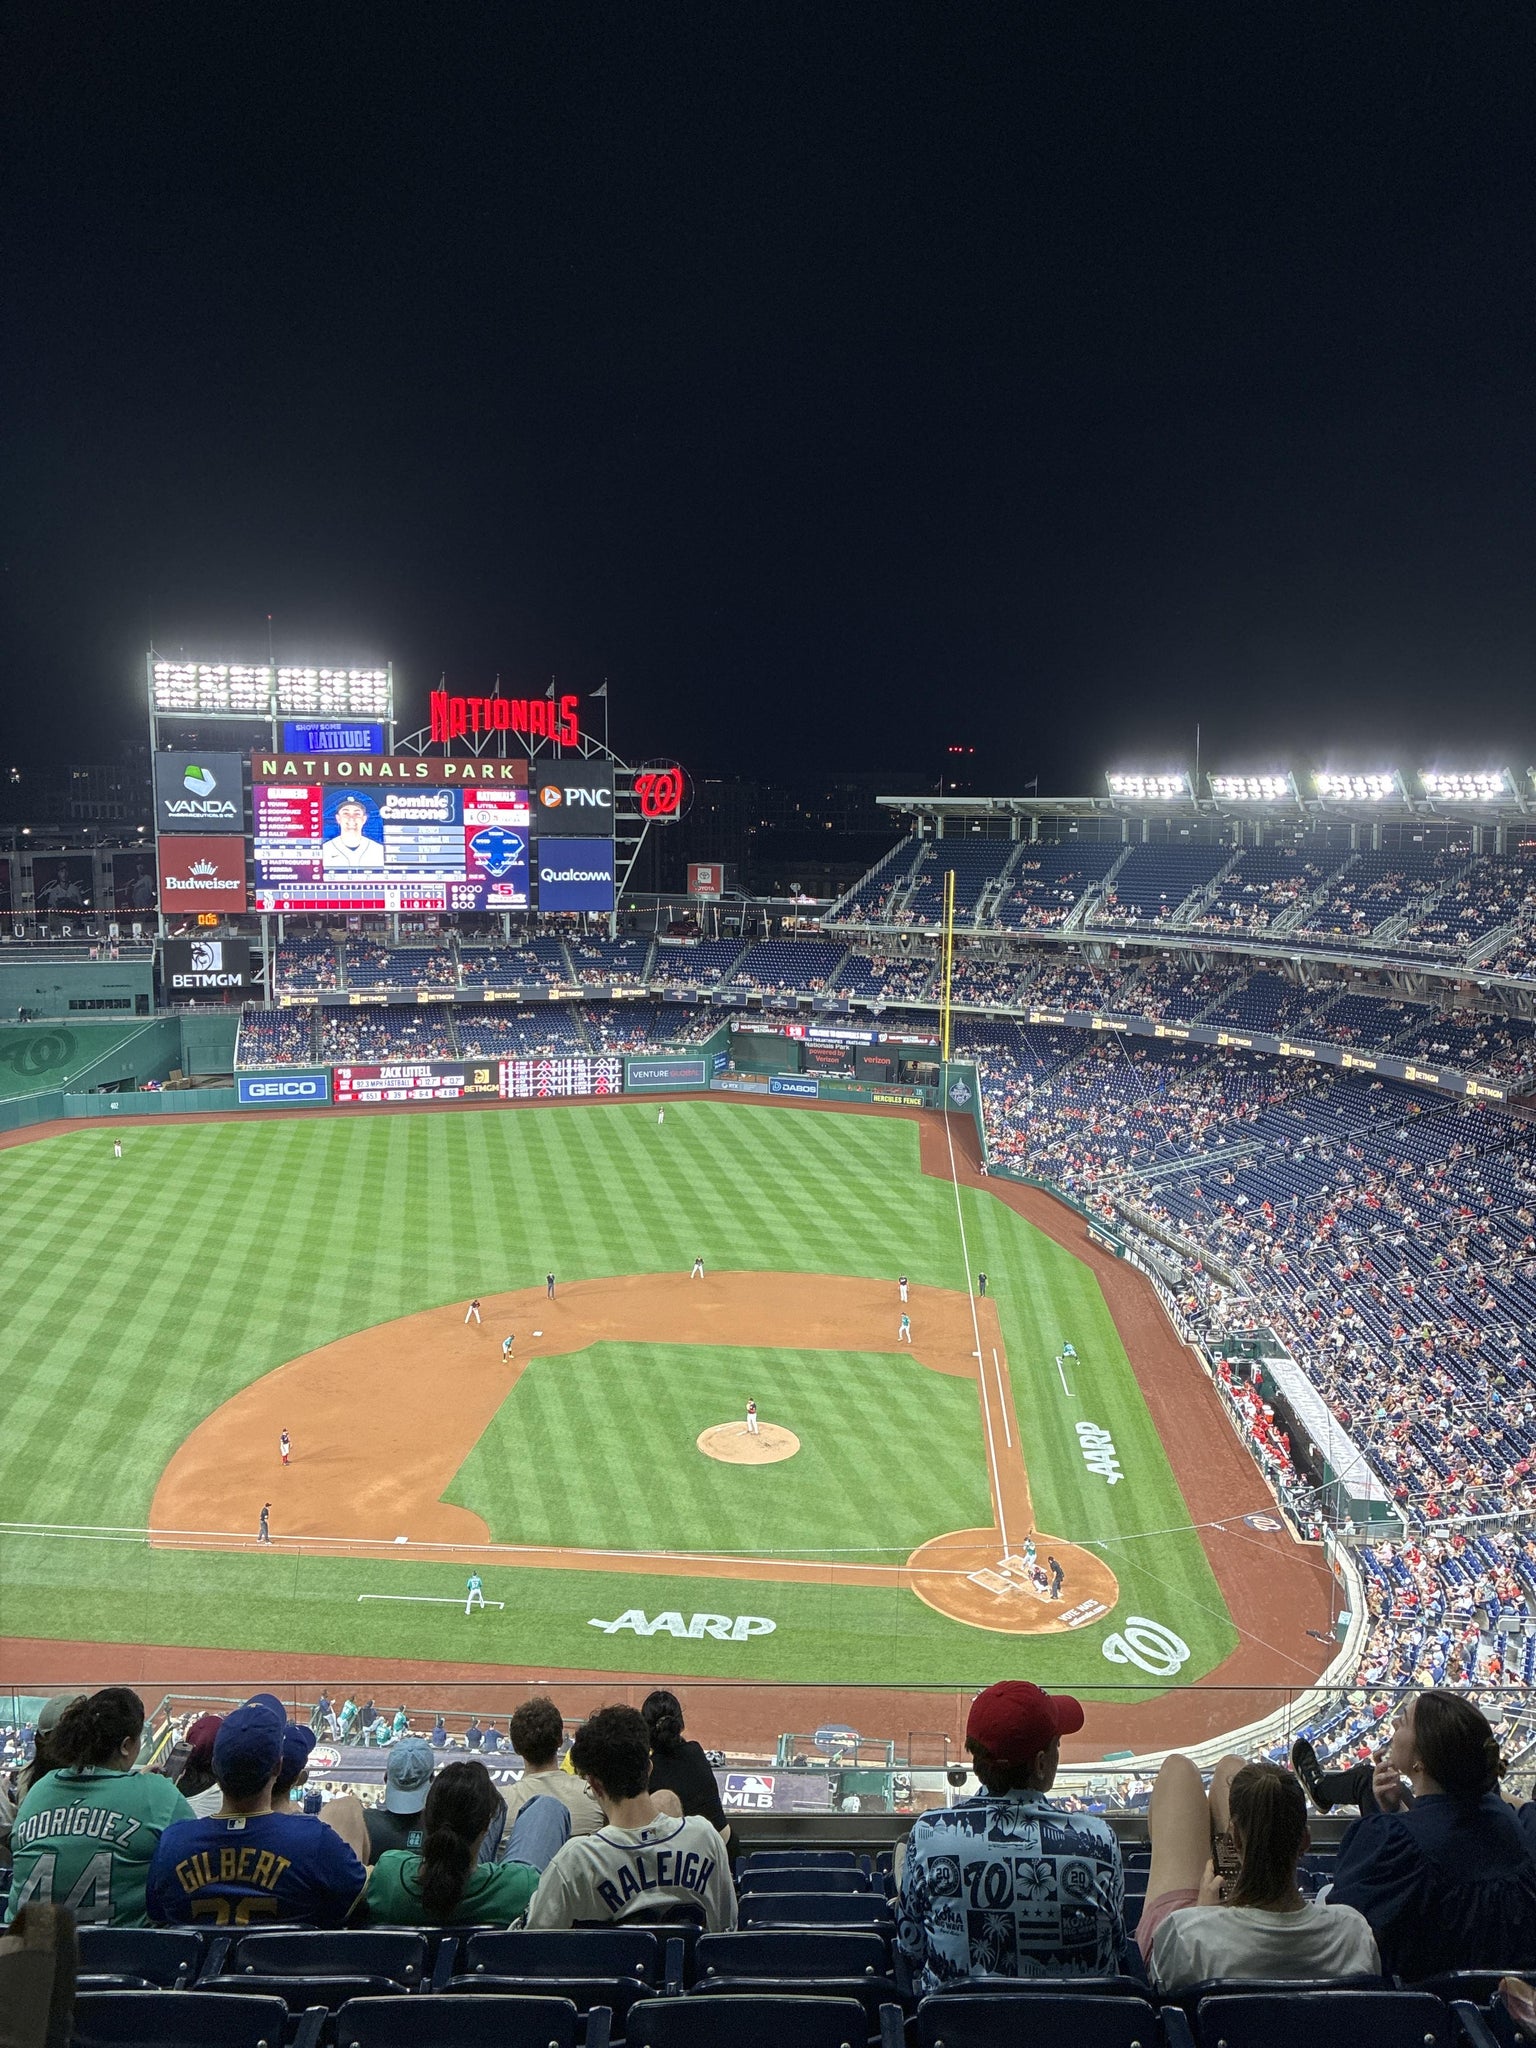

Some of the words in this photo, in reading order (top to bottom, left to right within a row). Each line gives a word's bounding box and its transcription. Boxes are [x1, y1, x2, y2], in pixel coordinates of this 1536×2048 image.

[430, 691, 578, 746] NATIONALS
[308, 730, 371, 749] NATITUDE
[262, 760, 428, 777] NATIONALS
[444, 764, 514, 779] PARK
[386, 795, 448, 807] Dominic
[564, 788, 611, 807] PNC
[165, 800, 237, 813] VANDA
[380, 806, 448, 819] Canzone
[540, 868, 611, 882] Qualcomm
[165, 877, 240, 889] Budweiser
[172, 974, 242, 988] BETMGM
[1165, 1028, 1189, 1037] BETMGM
[1228, 1037, 1252, 1046] BETMGM
[809, 1049, 837, 1057] powered
[1290, 1046, 1315, 1057] BETMGM
[815, 1055, 840, 1063] Verizon
[863, 1057, 891, 1065] verizon
[1352, 1058, 1376, 1070] BETMGM
[380, 1067, 402, 1078] ZACK
[402, 1065, 432, 1077] LITTELL
[632, 1070, 669, 1078] VENTURE
[670, 1069, 700, 1078] GLOBAL
[1415, 1071, 1439, 1083] BETMGM
[248, 1083, 317, 1096] GEICO
[384, 1079, 410, 1087] FASTBALL
[464, 1084, 499, 1093] BETMGM
[783, 1083, 816, 1093] DABOS
[1477, 1085, 1503, 1098] BETMGM
[873, 1095, 902, 1104] HERCULES
[903, 1097, 921, 1105] FENCE
[1075, 1421, 1124, 1485] AARP
[1057, 1608, 1080, 1621] VOTE
[588, 1608, 777, 1641] AARP
[722, 1792, 774, 1809] MLB
[18, 1799, 141, 1849] RODRÍGUEZ
[175, 1847, 291, 1894] GILBERT
[936, 1867, 950, 1880] 20
[597, 1851, 715, 1913] RALEIGH
[1071, 1871, 1086, 1884] 20
[17, 1852, 115, 1925] 44
